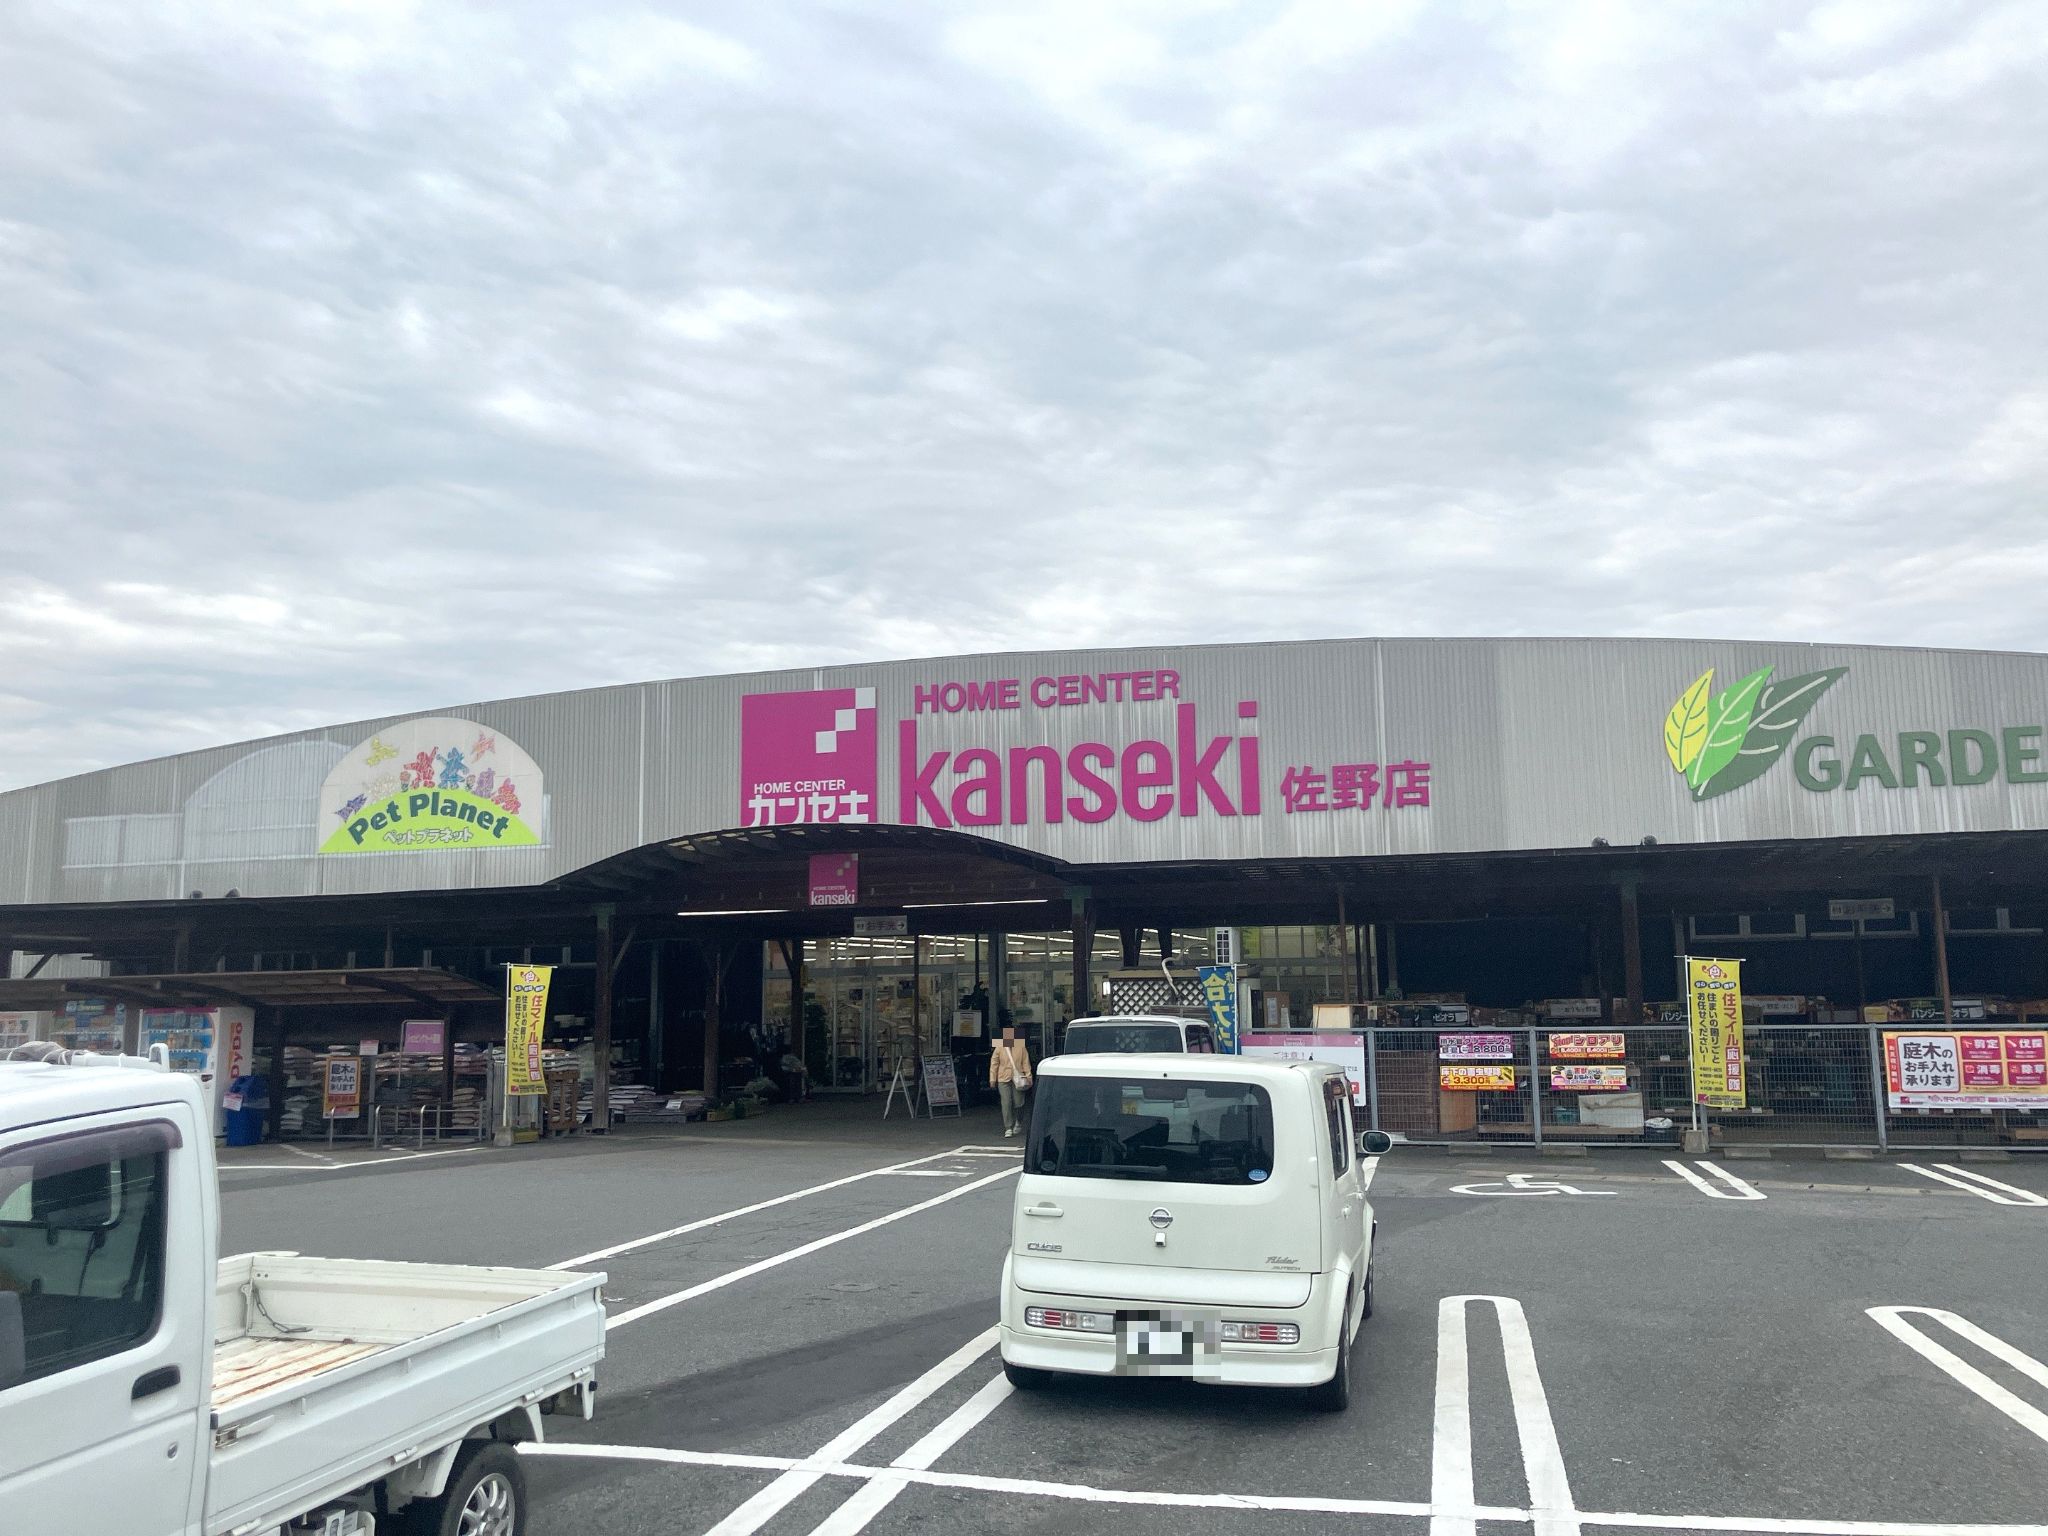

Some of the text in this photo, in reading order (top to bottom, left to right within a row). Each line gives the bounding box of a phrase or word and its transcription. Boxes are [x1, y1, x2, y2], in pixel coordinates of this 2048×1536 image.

[914, 670, 1180, 715] HOME CENTER
[898, 700, 1261, 828] kanseki
[754, 779, 846, 794] HOME CENTER
[1280, 760, 1430, 814] 佐野店
[348, 791, 510, 846] Pet Planet
[383, 827, 474, 845] ペットプラネット
[811, 889, 856, 906] kanseki
[1903, 1042, 1953, 1059] 庭木の
[1905, 1061, 1954, 1073] お手入れ
[1905, 1074, 1955, 1086] 承ります
